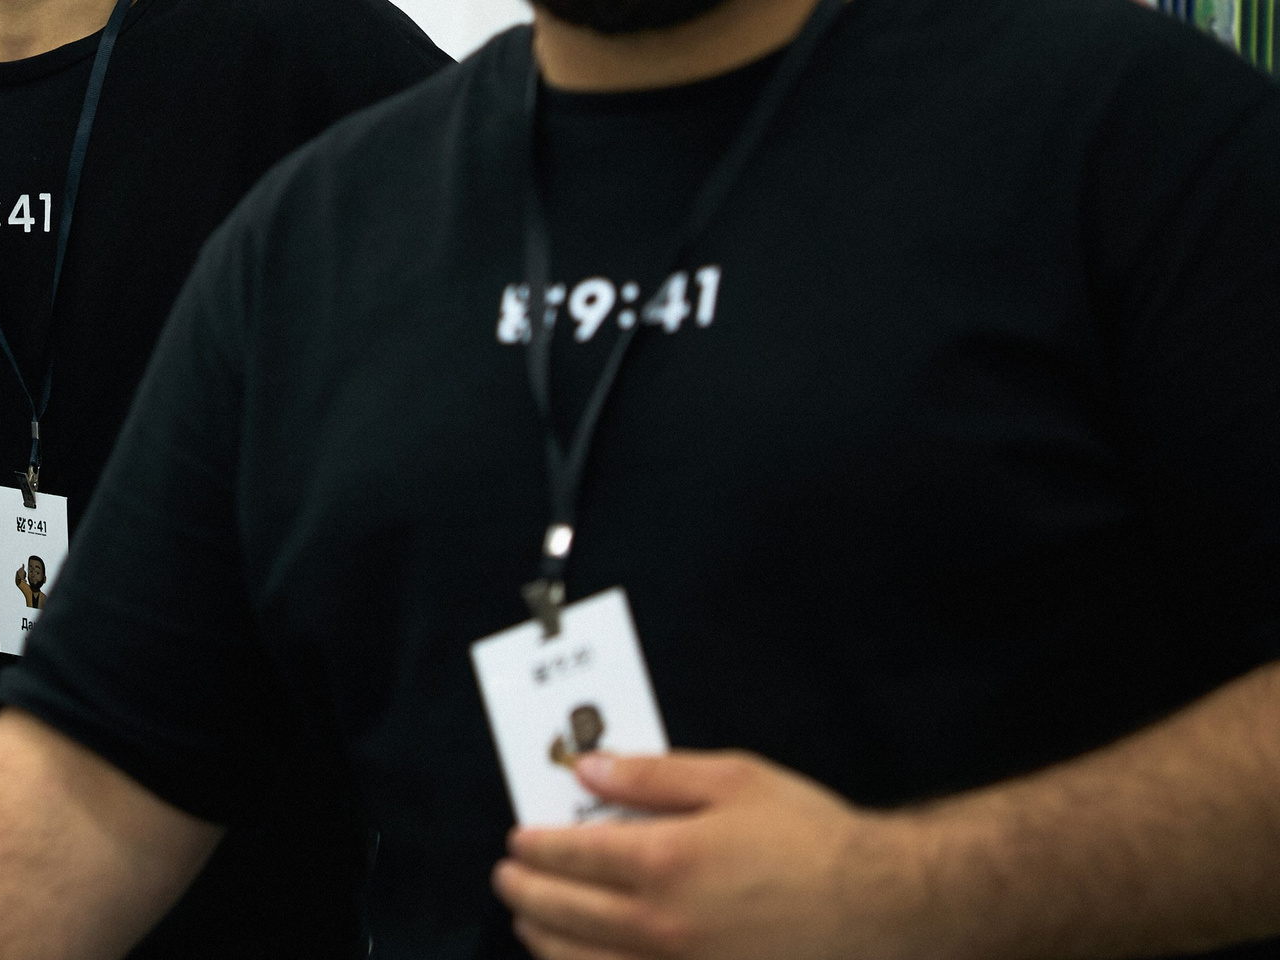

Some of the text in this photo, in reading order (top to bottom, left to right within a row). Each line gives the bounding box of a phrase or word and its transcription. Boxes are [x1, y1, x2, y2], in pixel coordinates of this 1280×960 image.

[567, 264, 722, 343] 9:41
[27, 518, 47, 533] 9:41
[21, 617, 38, 632] Да
